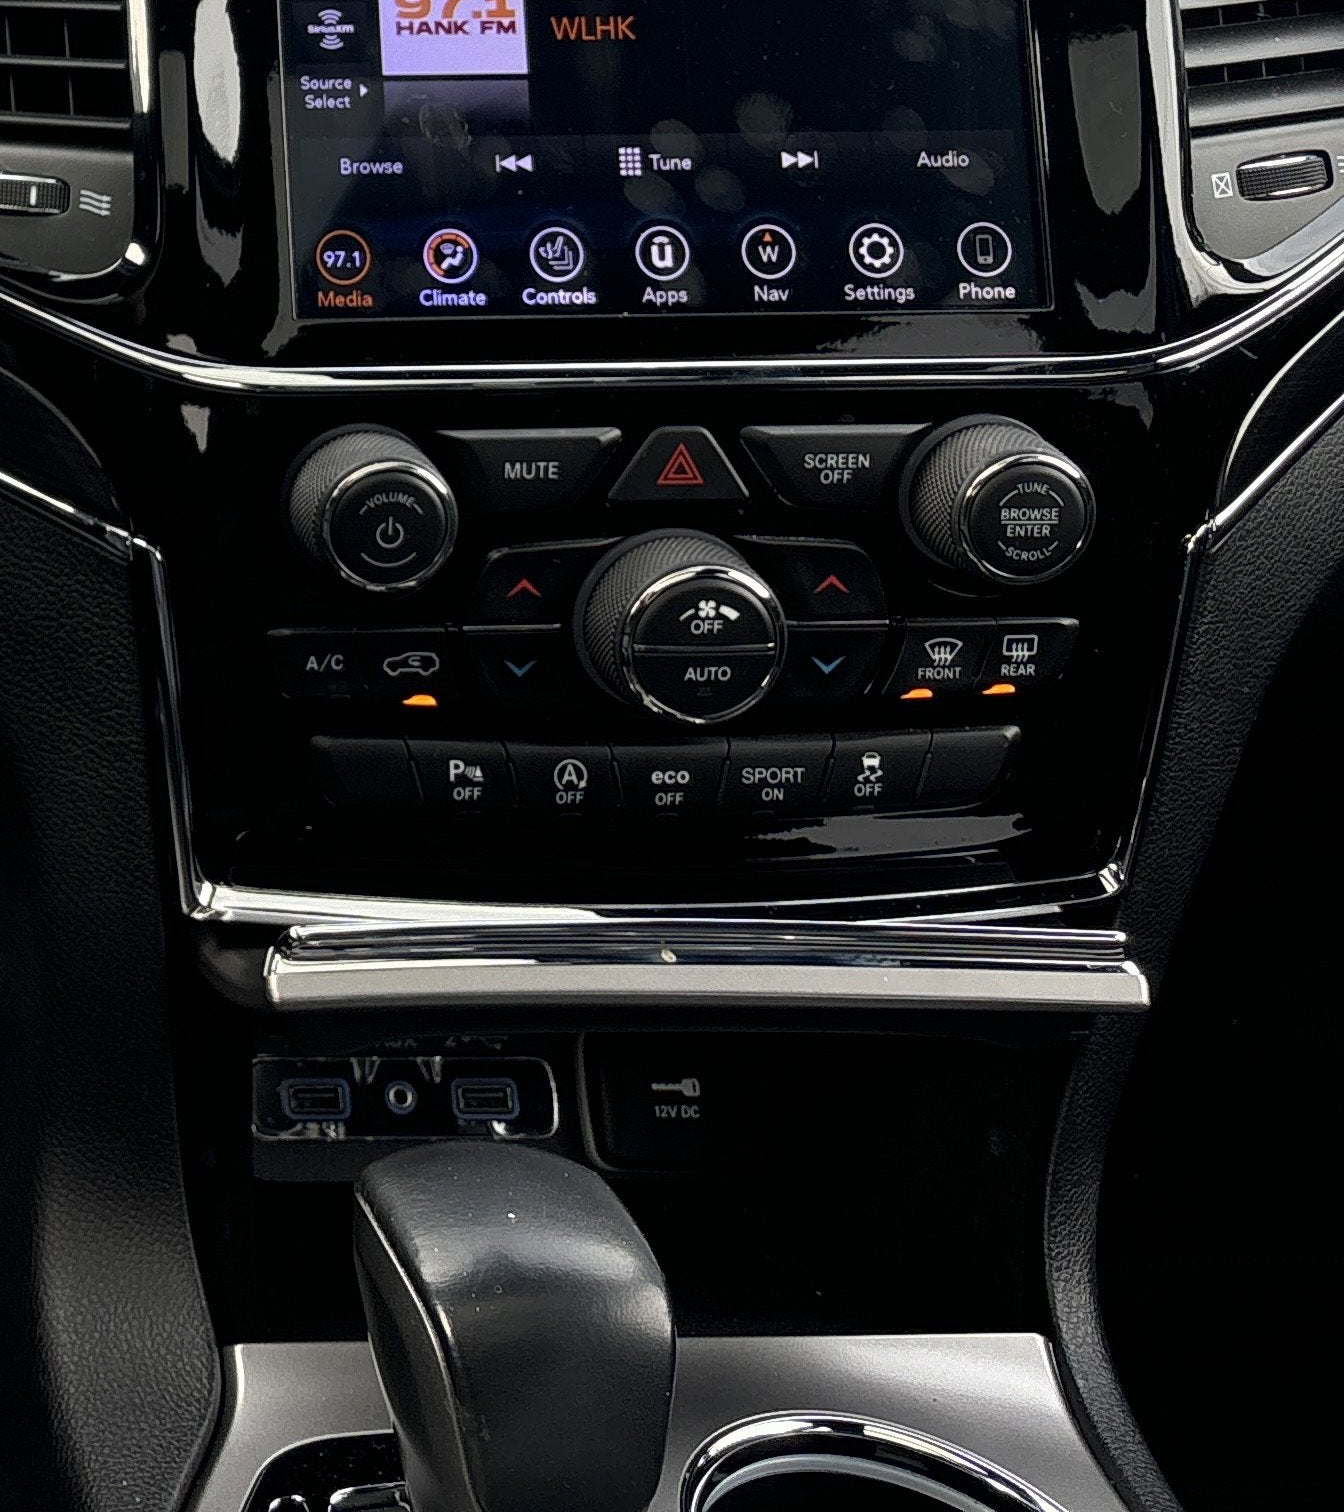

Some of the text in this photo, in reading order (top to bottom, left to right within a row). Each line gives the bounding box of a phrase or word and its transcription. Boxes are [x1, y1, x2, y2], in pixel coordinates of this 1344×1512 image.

[396, 20, 517, 35] HANK FM
[550, 16, 636, 41] WLHK
[300, 76, 352, 90] Source
[305, 95, 350, 109] Select
[340, 158, 403, 175] Browse
[648, 154, 692, 171] Tune
[917, 151, 970, 168] Audio
[323, 250, 362, 268] 97.1
[759, 245, 780, 263] W
[419, 289, 487, 307] Climate
[522, 288, 596, 305] Controls
[642, 287, 688, 306] Apps
[754, 285, 789, 301] Nav
[844, 284, 915, 304] Settings
[959, 283, 1016, 299] Phone
[318, 291, 373, 308] Media
[804, 453, 870, 469] SCREEN
[504, 462, 559, 480] MUTE
[820, 470, 853, 485] OFF
[1017, 481, 1050, 496] TUNE
[365, 493, 414, 509] VOLUME
[1000, 507, 1059, 522] BROWSE
[1006, 524, 1051, 538] ENTER
[1005, 545, 1052, 562] SCROLL
[690, 620, 723, 635] OFF
[305, 654, 344, 671] A/C
[1000, 664, 1036, 677] REAR
[684, 666, 732, 683] AUTO
[917, 667, 962, 681] FRONT
[651, 770, 690, 785] eco
[741, 768, 805, 785] SPORT
[453, 787, 482, 801] OFF
[555, 791, 585, 804] OFF
[762, 787, 784, 801] ON
[854, 783, 882, 797] OFF
[655, 792, 684, 806] OFF
[654, 1104, 701, 1119] 12V DC
